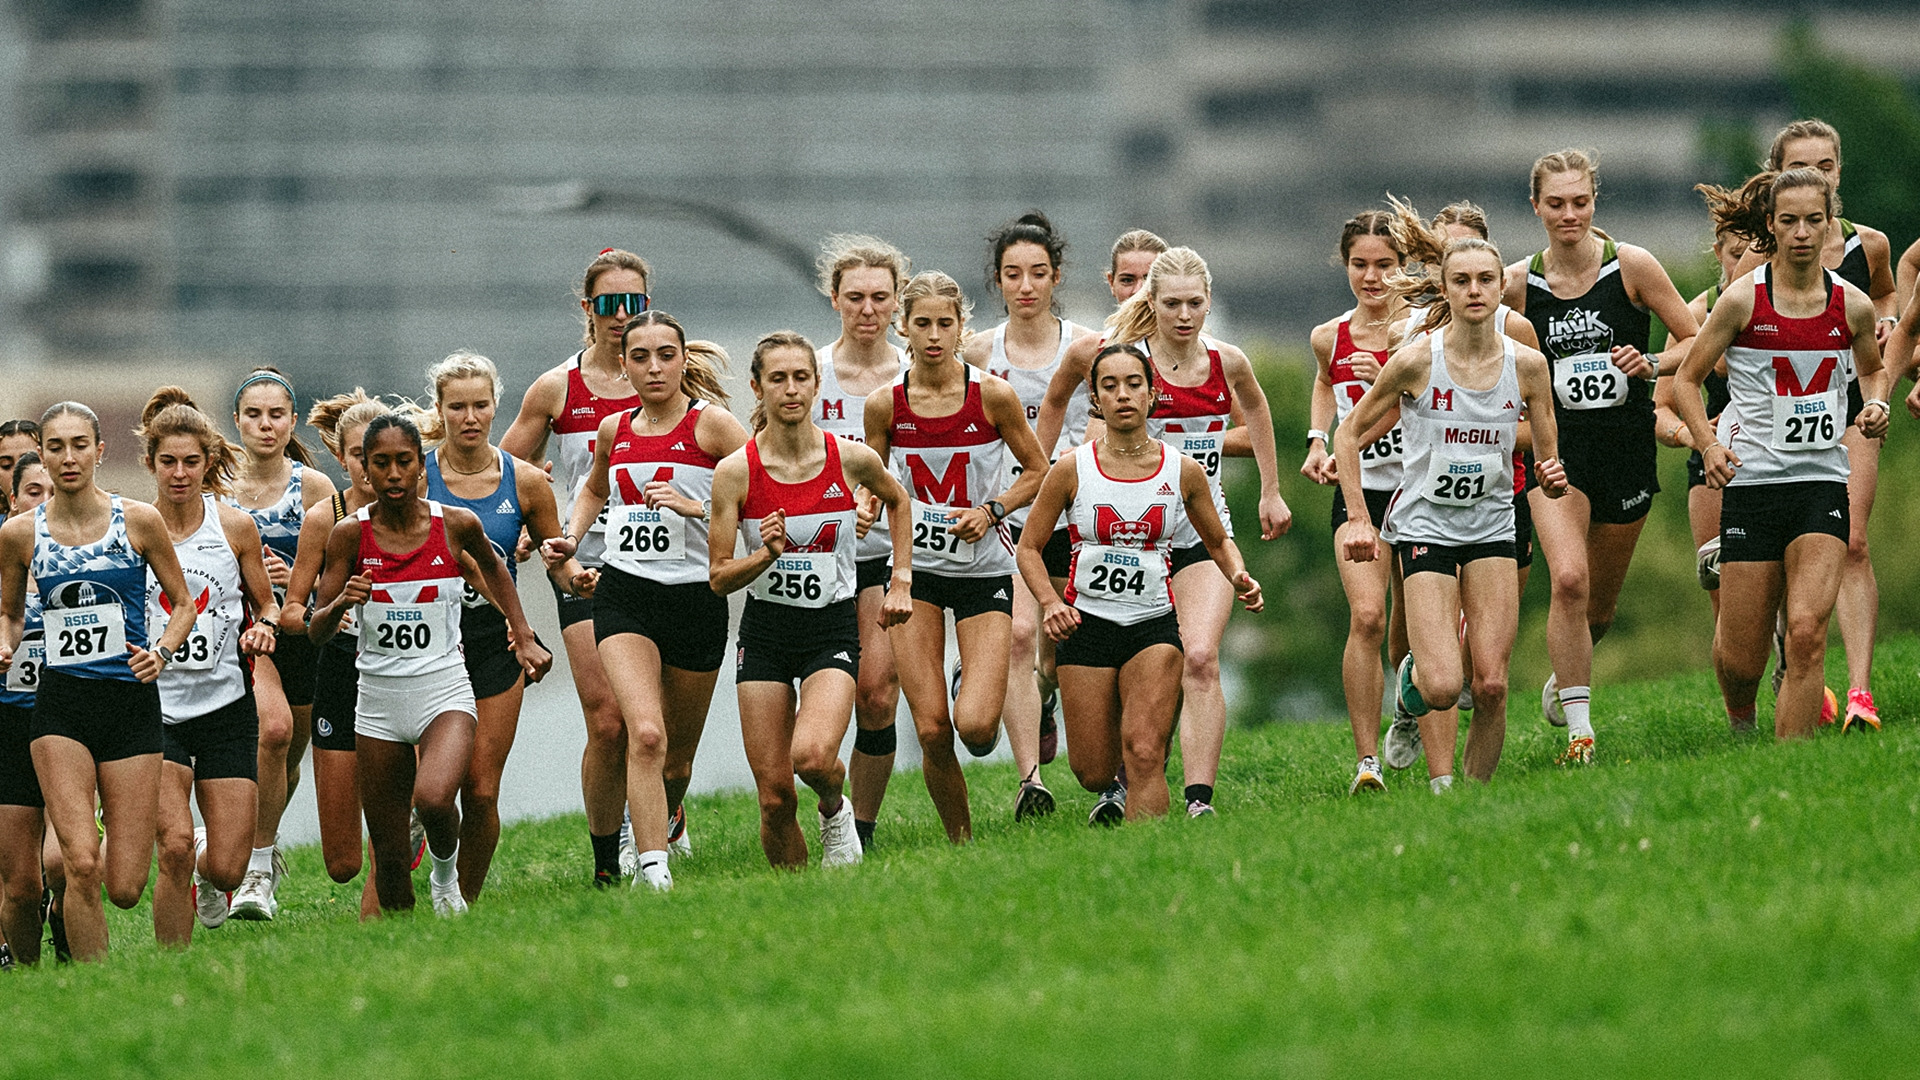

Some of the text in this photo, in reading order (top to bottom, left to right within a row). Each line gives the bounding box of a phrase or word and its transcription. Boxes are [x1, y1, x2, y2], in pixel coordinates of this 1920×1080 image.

[1561, 337, 1600, 351] UQAC
[1573, 360, 1608, 373] RSEQ
[1772, 356, 1838, 396] M
[1431, 387, 1454, 411] M
[1567, 374, 1617, 403] 362
[572, 407, 596, 415] McGILL
[821, 399, 846, 420] M
[1794, 401, 1827, 414] RSEQ
[1445, 428, 1500, 445] McGILL
[1785, 414, 1834, 443] 276
[1184, 439, 1216, 450] RSEQ
[906, 452, 972, 508] M
[1448, 463, 1482, 474] RSEQ
[1434, 475, 1486, 500] 261
[628, 512, 661, 522] RSEQ
[1093, 504, 1167, 551] M
[619, 525, 670, 552] 266
[913, 523, 960, 553] 257
[776, 560, 812, 571] RSEQ
[1103, 553, 1140, 566] RSEQ
[768, 571, 821, 600] 256
[1089, 565, 1146, 595] 264
[63, 613, 99, 627] RSEQ
[386, 610, 422, 621] RSEQ
[59, 626, 108, 657] 287
[158, 635, 208, 662] 93
[377, 623, 431, 650] 260
